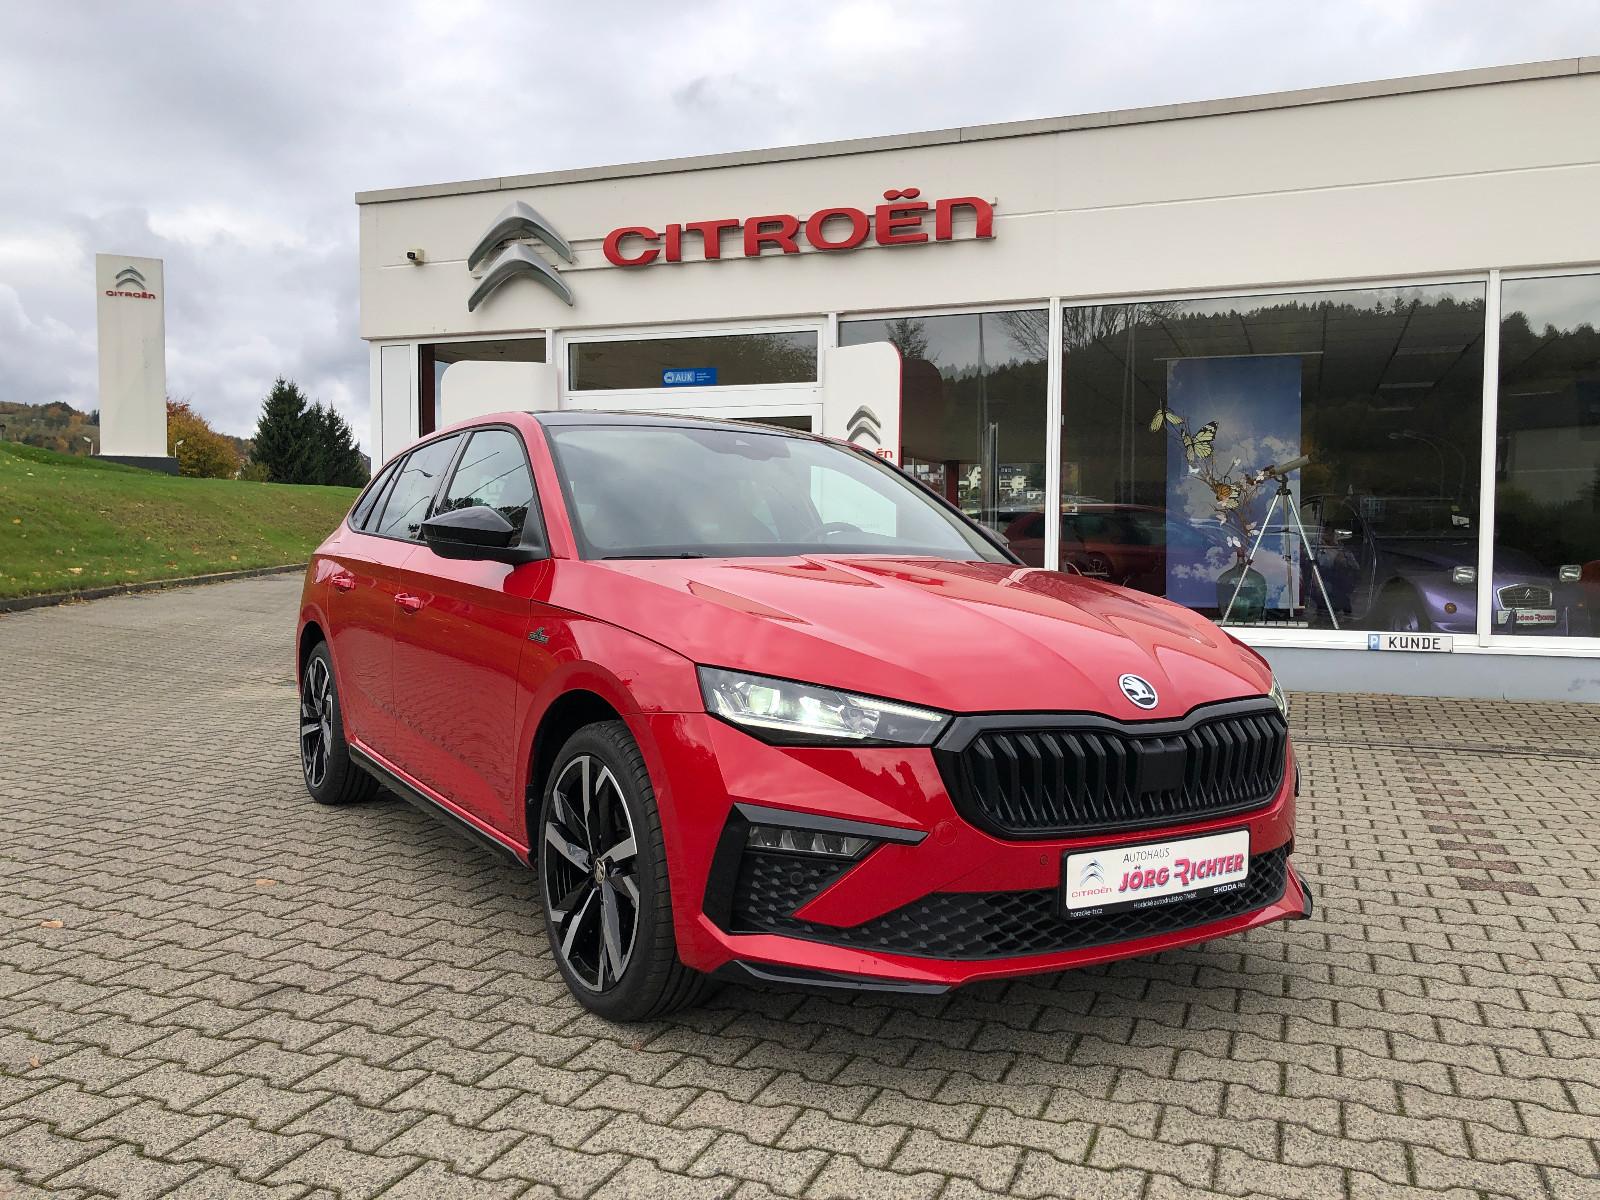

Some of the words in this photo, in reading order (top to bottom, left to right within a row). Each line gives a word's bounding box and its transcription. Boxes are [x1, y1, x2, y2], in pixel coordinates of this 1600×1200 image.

[1370, 636, 1379, 649] P
[1388, 636, 1441, 650] KUNDE
[1122, 847, 1170, 864] AUTOHAUS
[1118, 864, 1170, 892] JÖRG
[1174, 853, 1244, 887] RICHTER
